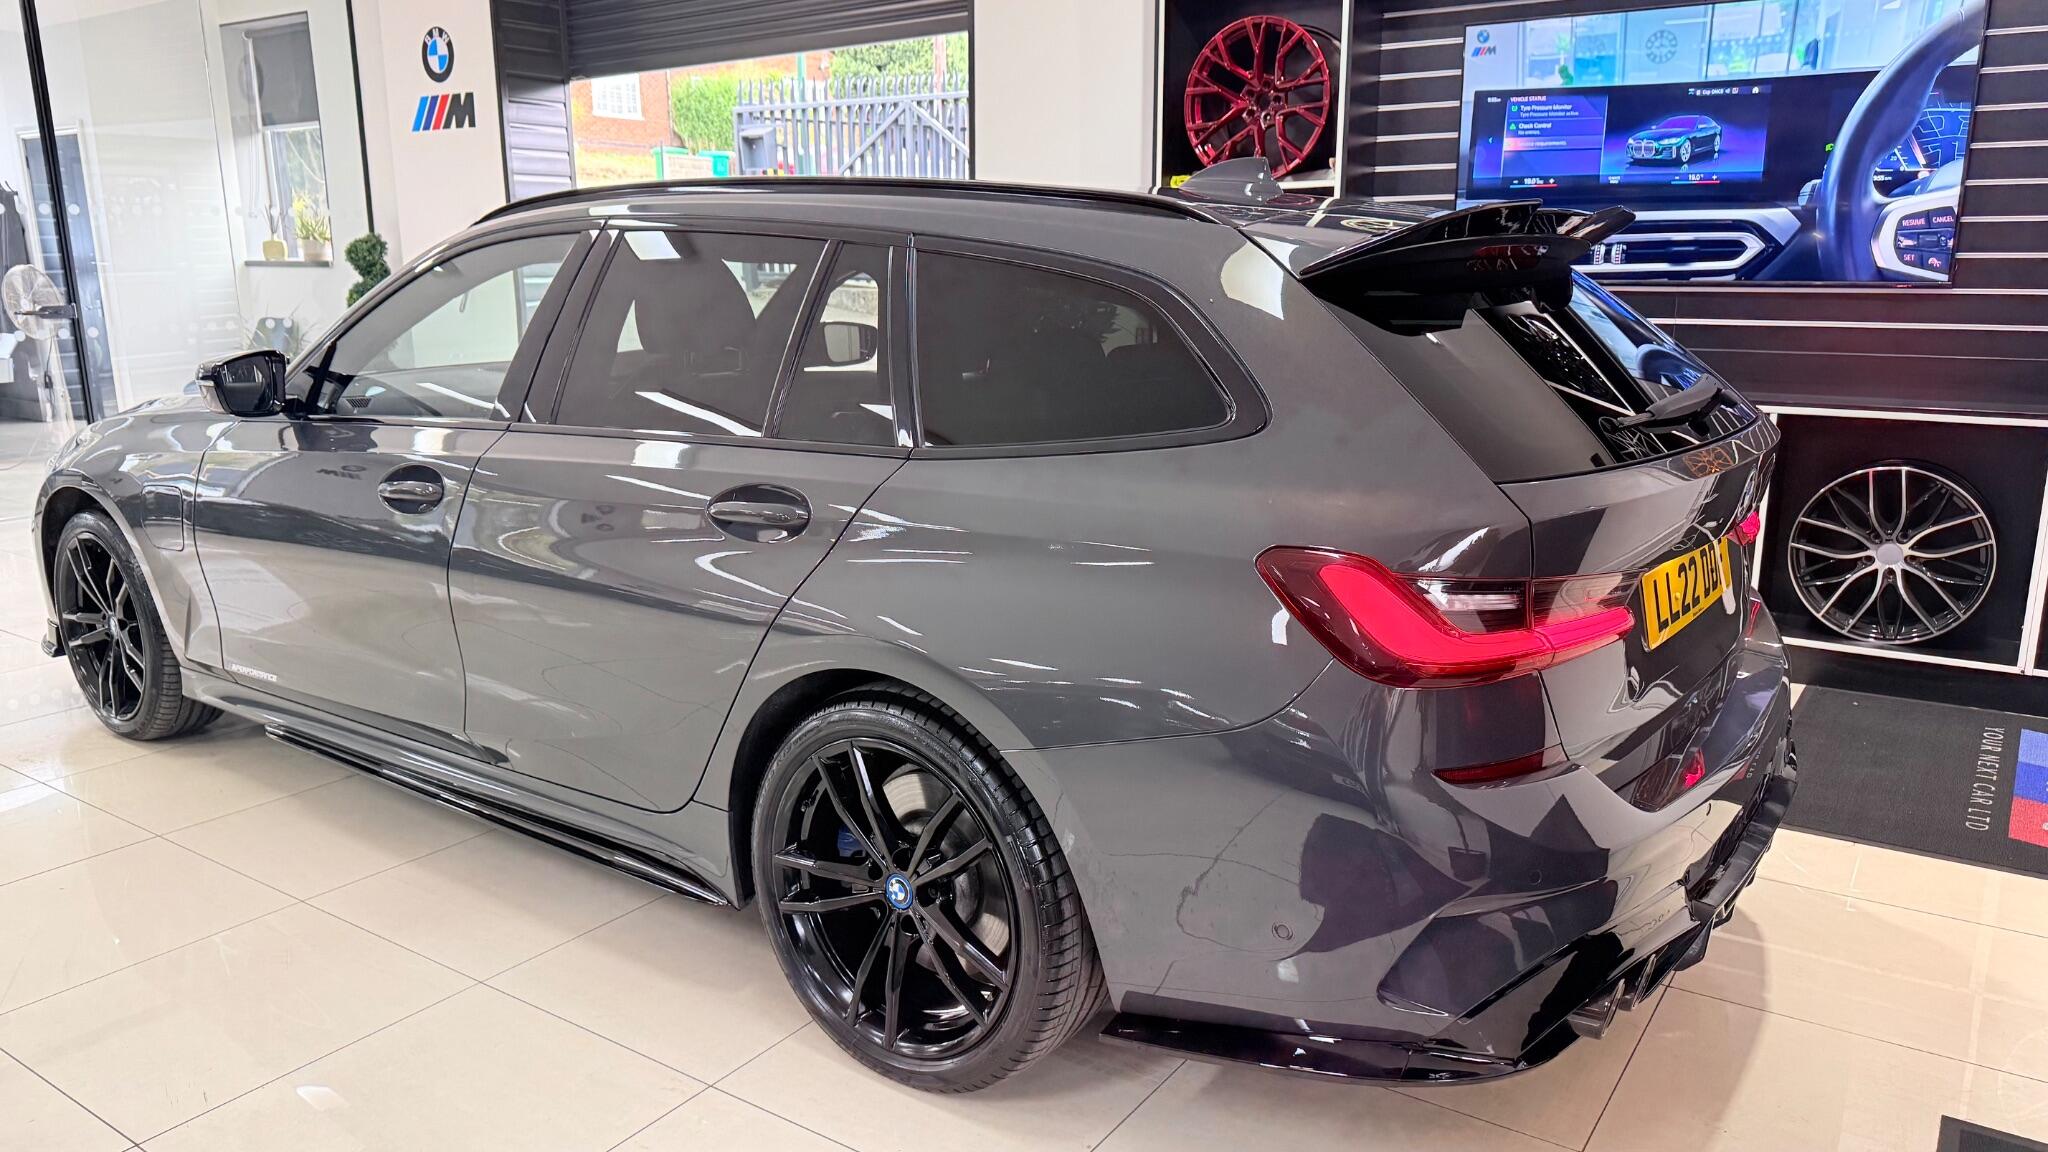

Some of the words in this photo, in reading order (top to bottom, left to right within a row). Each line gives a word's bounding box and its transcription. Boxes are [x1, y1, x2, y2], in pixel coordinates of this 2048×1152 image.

[1902, 218, 1925, 227] RESUME
[1932, 216, 1954, 224] CANCEL
[1903, 253, 1915, 261] SET
[1980, 727, 2005, 752] YOUR
[1976, 753, 2001, 781] NEXT
[1972, 782, 1996, 805] CAR
[1965, 807, 1992, 831] LTD
